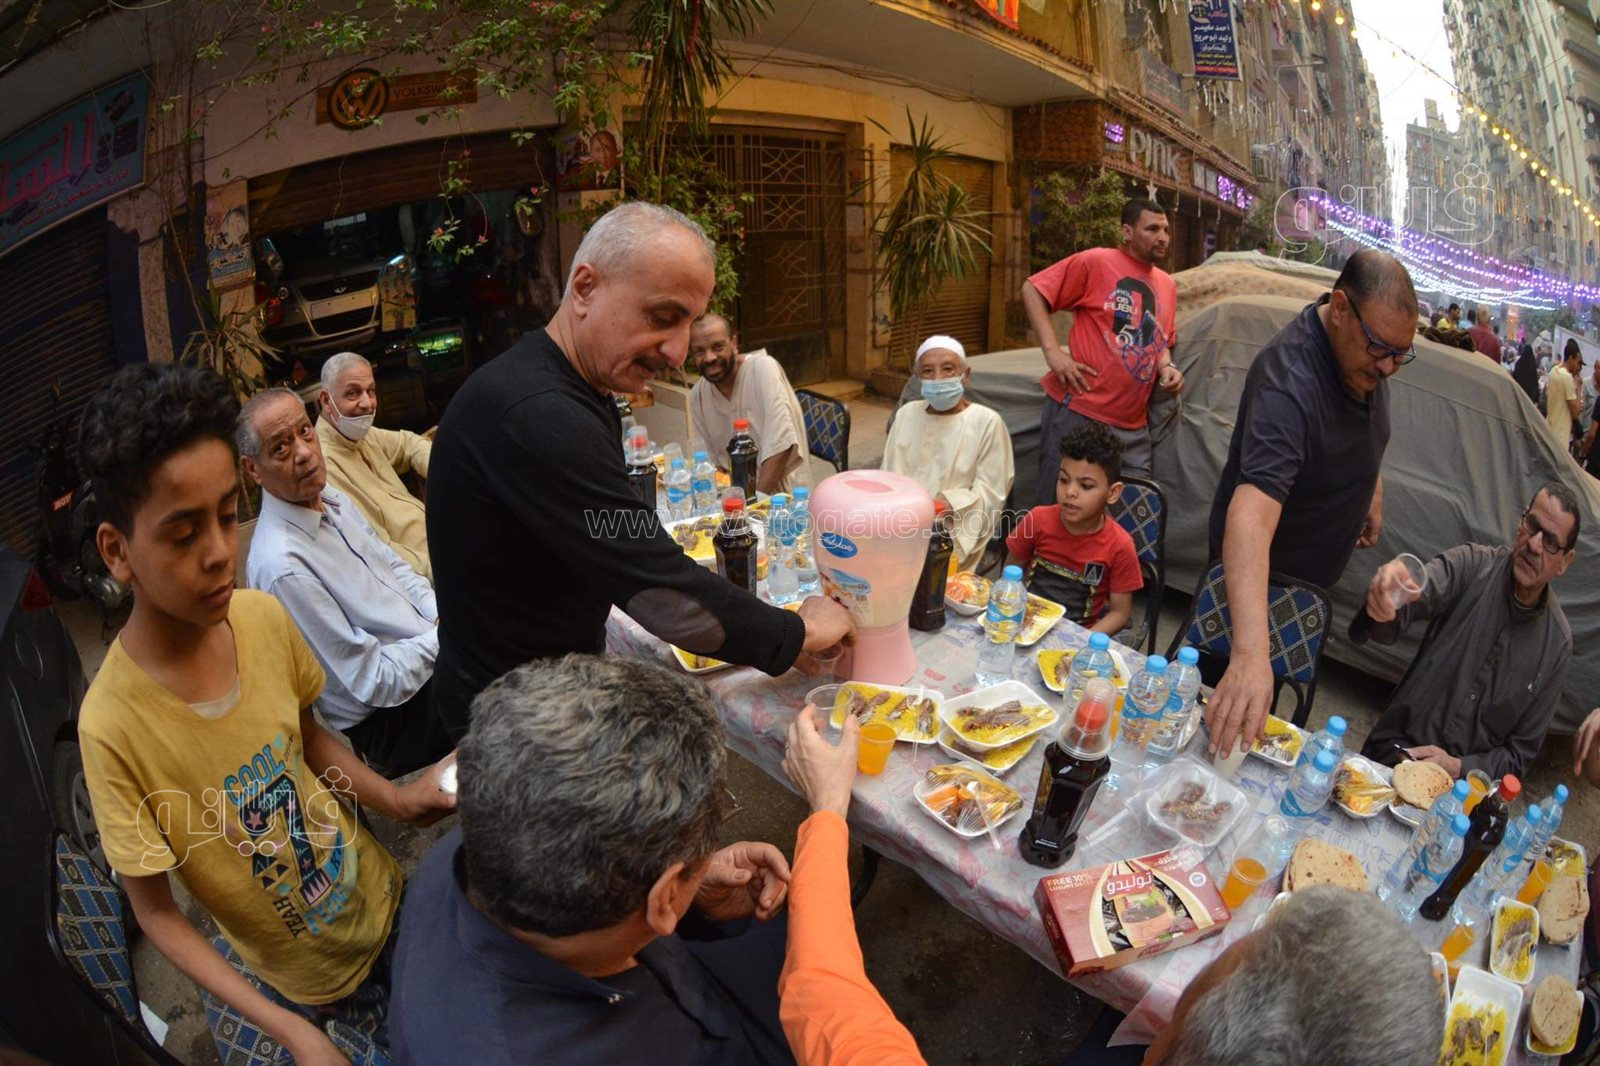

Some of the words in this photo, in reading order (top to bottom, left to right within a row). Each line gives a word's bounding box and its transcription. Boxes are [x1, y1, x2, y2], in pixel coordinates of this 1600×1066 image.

[1103, 301, 1139, 315] FUBU
[223, 743, 286, 807] COOL
[1046, 876, 1073, 888] FREE
[1106, 871, 1152, 895] توليدو
[272, 895, 307, 938] YEAH
